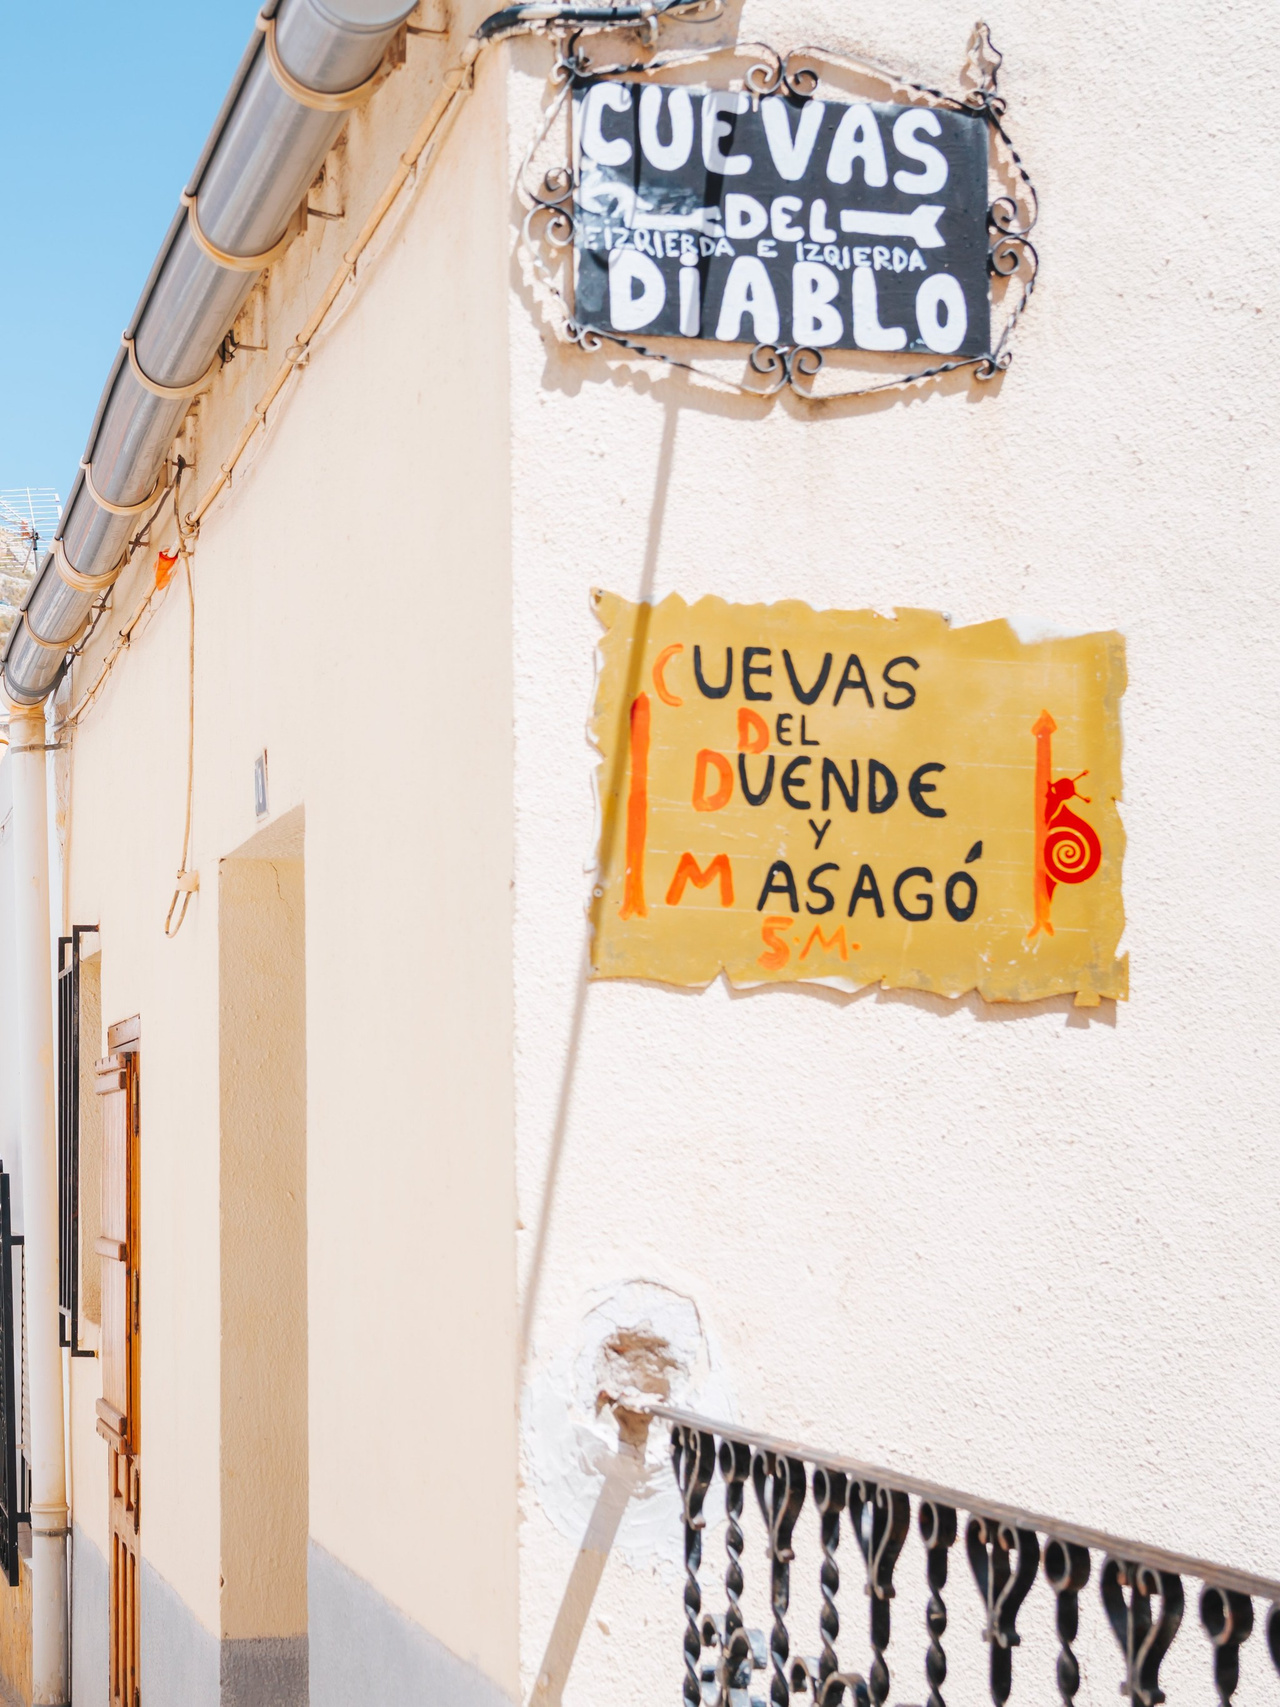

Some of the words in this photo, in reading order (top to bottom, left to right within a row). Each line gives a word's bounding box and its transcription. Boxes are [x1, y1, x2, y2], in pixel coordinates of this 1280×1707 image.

[580, 81, 948, 195] CUEVAS
[724, 192, 837, 244] DEL
[756, 238, 778, 258] E
[651, 642, 921, 711] CUEVAS
[737, 706, 821, 755] DEL
[691, 748, 948, 818] DUENDE
[808, 817, 832, 850] Y
[664, 839, 983, 922] MASAGÓ
